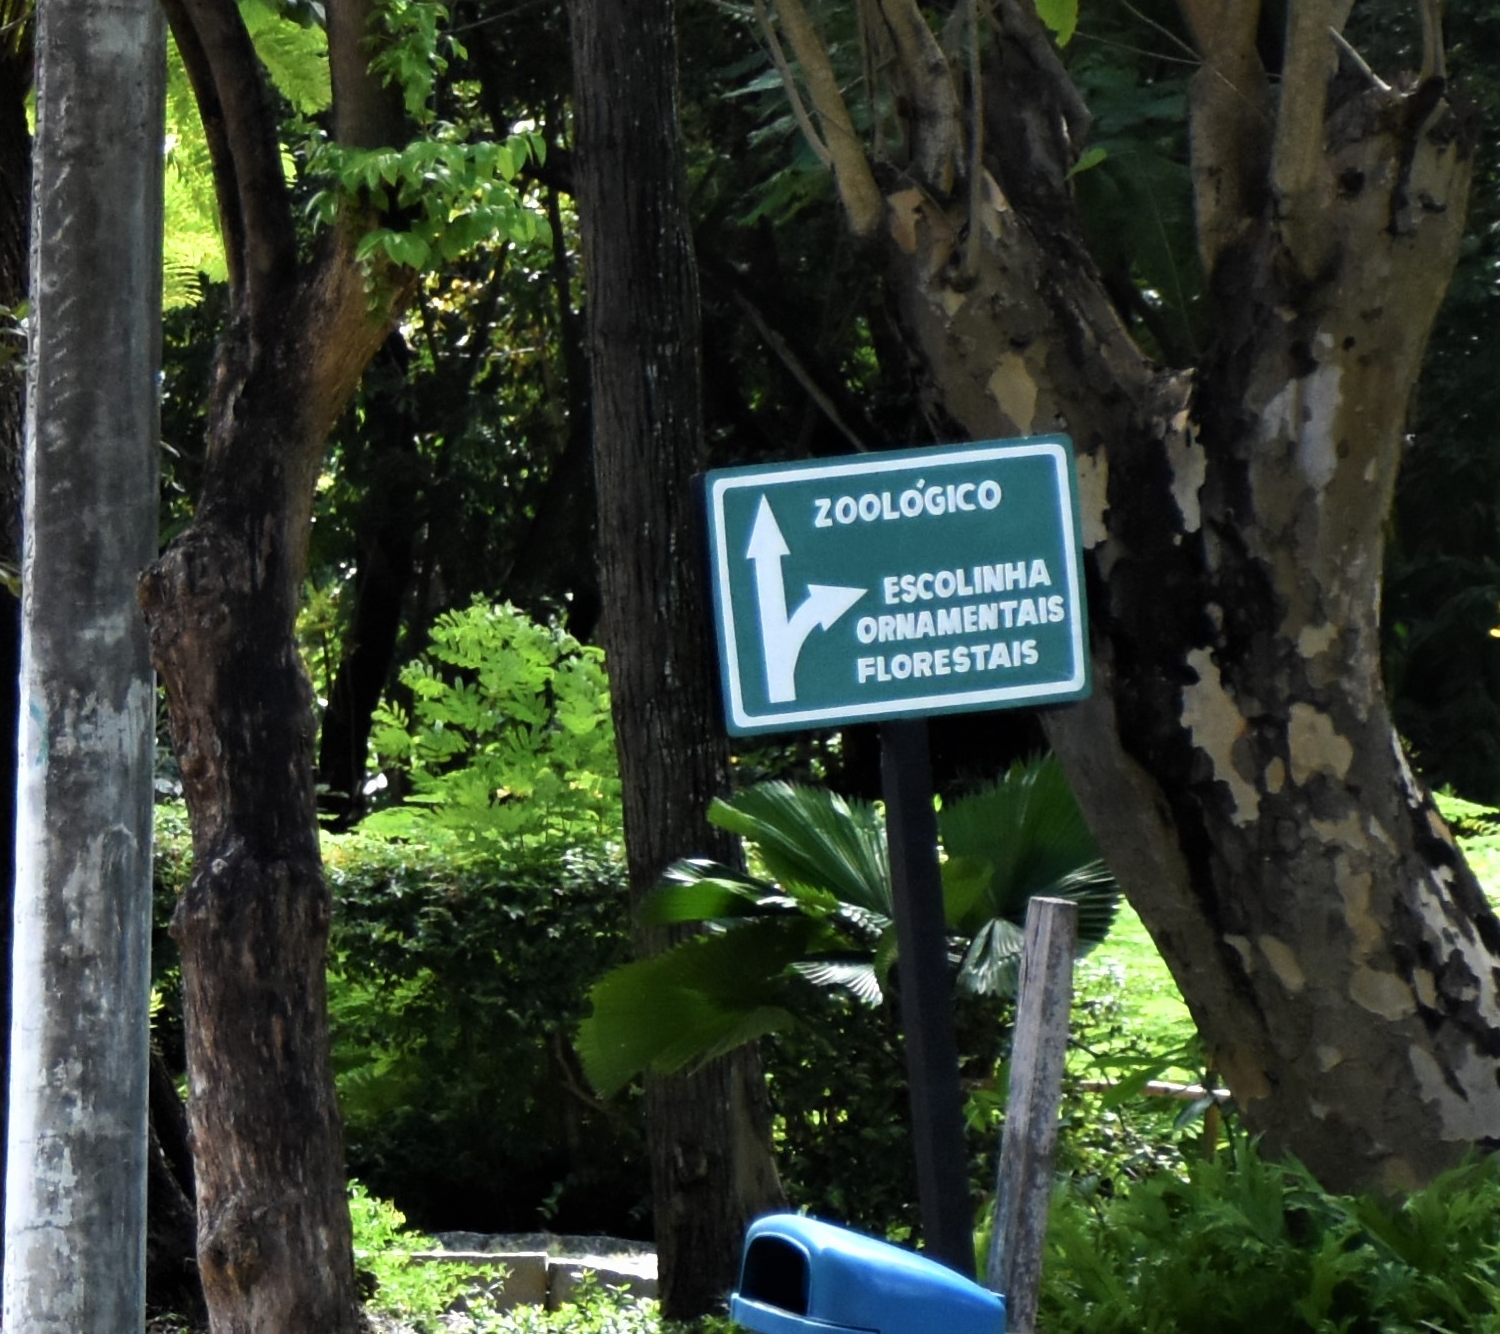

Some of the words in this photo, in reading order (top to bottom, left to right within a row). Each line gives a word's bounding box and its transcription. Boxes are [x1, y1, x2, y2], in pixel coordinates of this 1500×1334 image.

[813, 478, 1002, 528] ZOOLÓGICO
[883, 559, 1052, 605] ESCOLINHA
[856, 595, 1065, 644] ORNAMENTAIS
[857, 639, 1039, 684] FLORESTAIS
